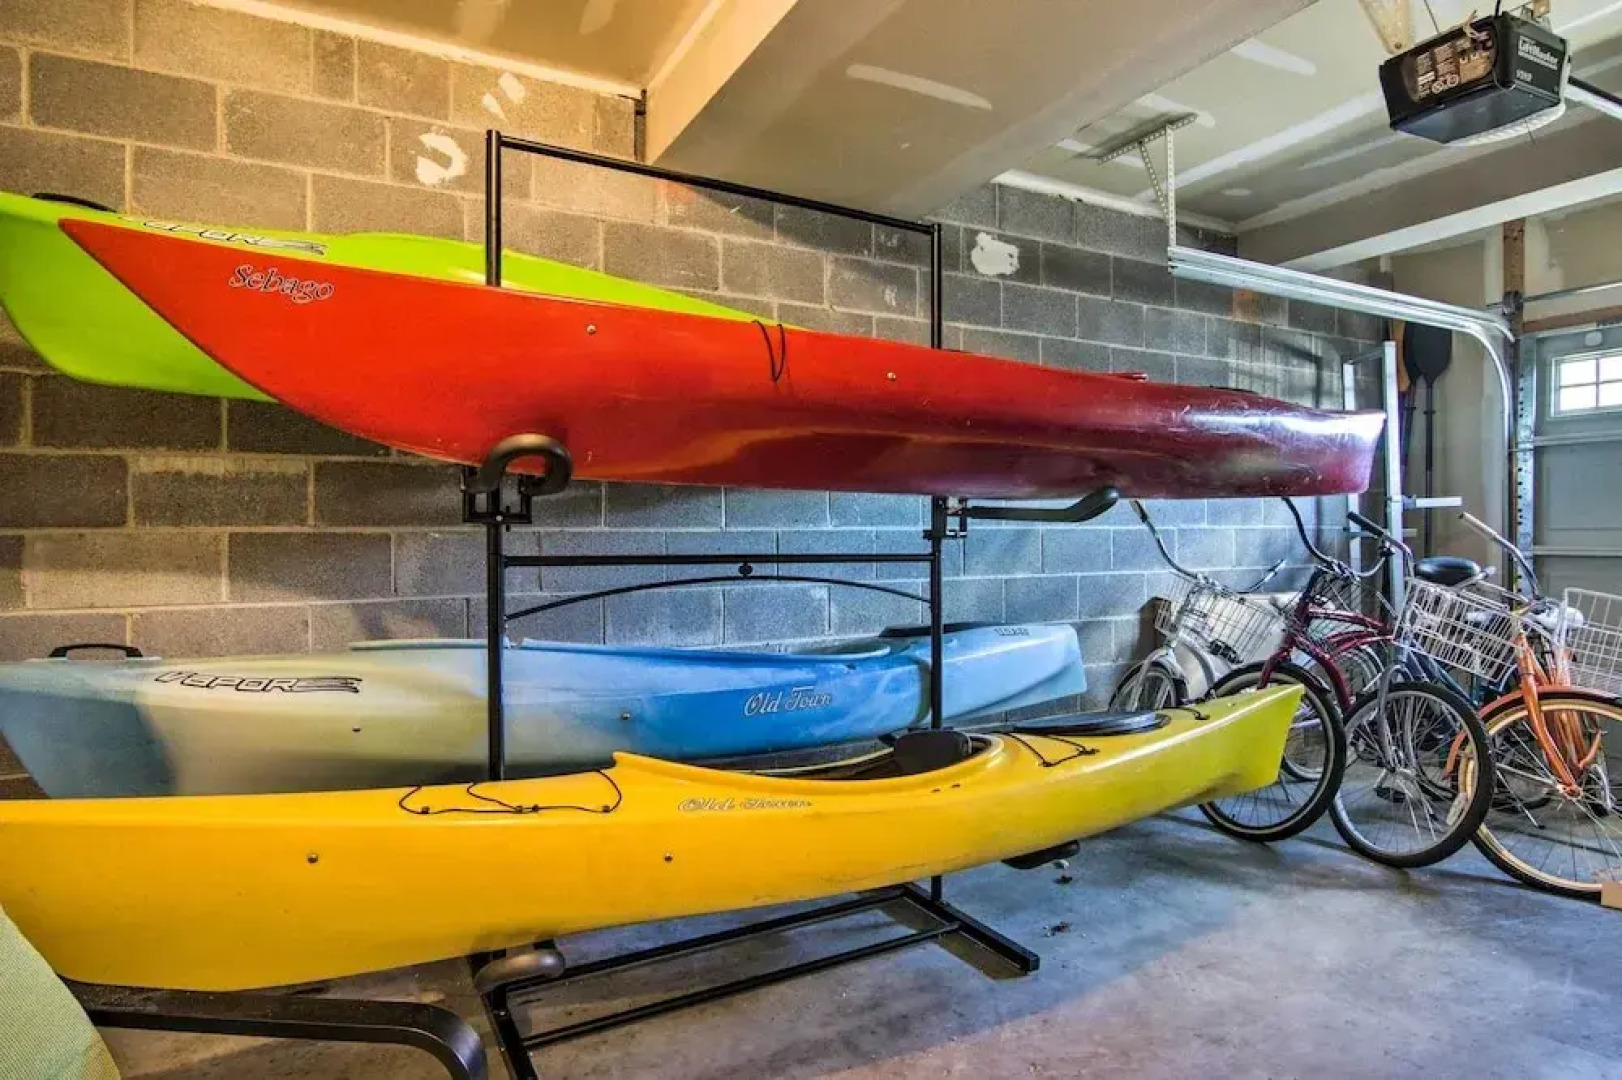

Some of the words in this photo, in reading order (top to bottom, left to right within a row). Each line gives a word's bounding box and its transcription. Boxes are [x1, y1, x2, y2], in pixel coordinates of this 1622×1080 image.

[229, 265, 335, 304] Sebago
[743, 691, 783, 717] Old
[784, 685, 832, 711] Town
